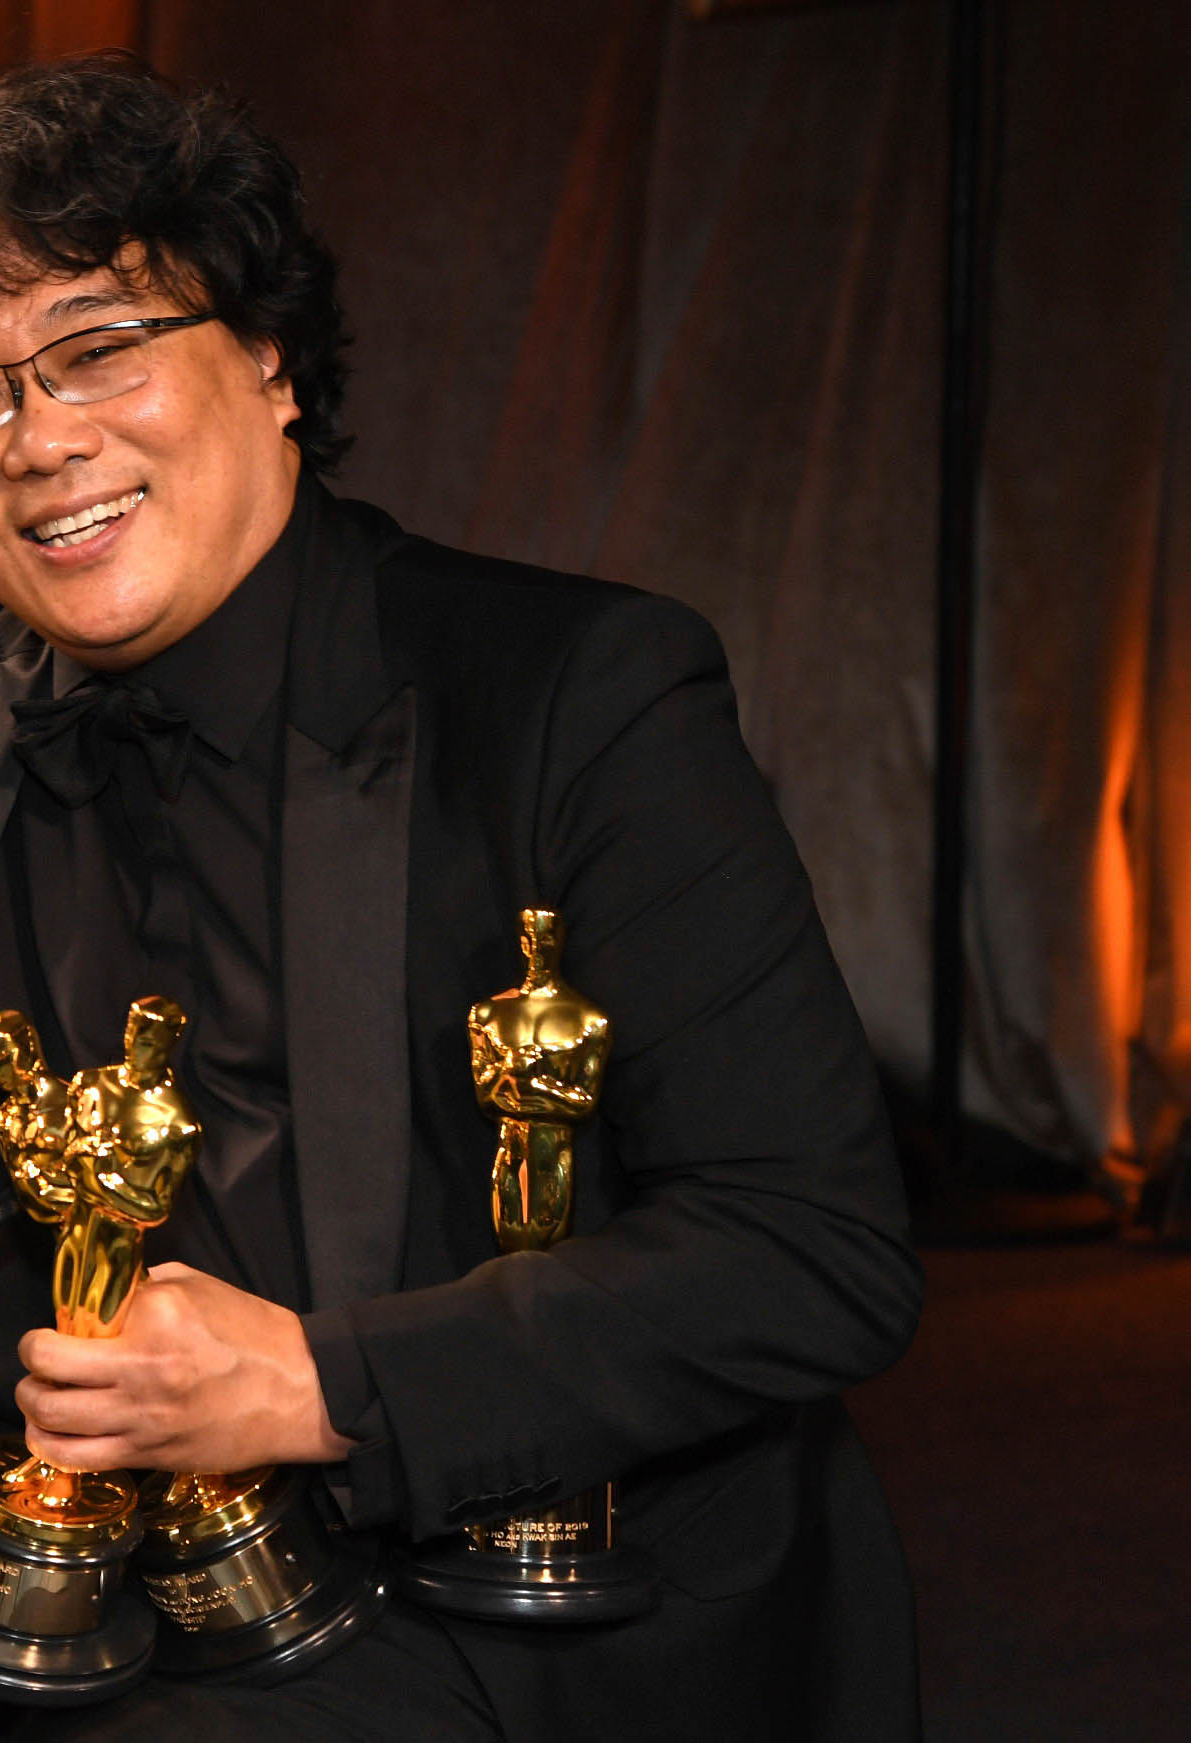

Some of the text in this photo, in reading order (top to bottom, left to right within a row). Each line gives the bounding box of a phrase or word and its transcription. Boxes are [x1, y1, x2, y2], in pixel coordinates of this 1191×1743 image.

[547, 1522, 562, 1532] OF
[564, 1521, 588, 1530] 2019
[522, 1532, 546, 1541] KWAK
